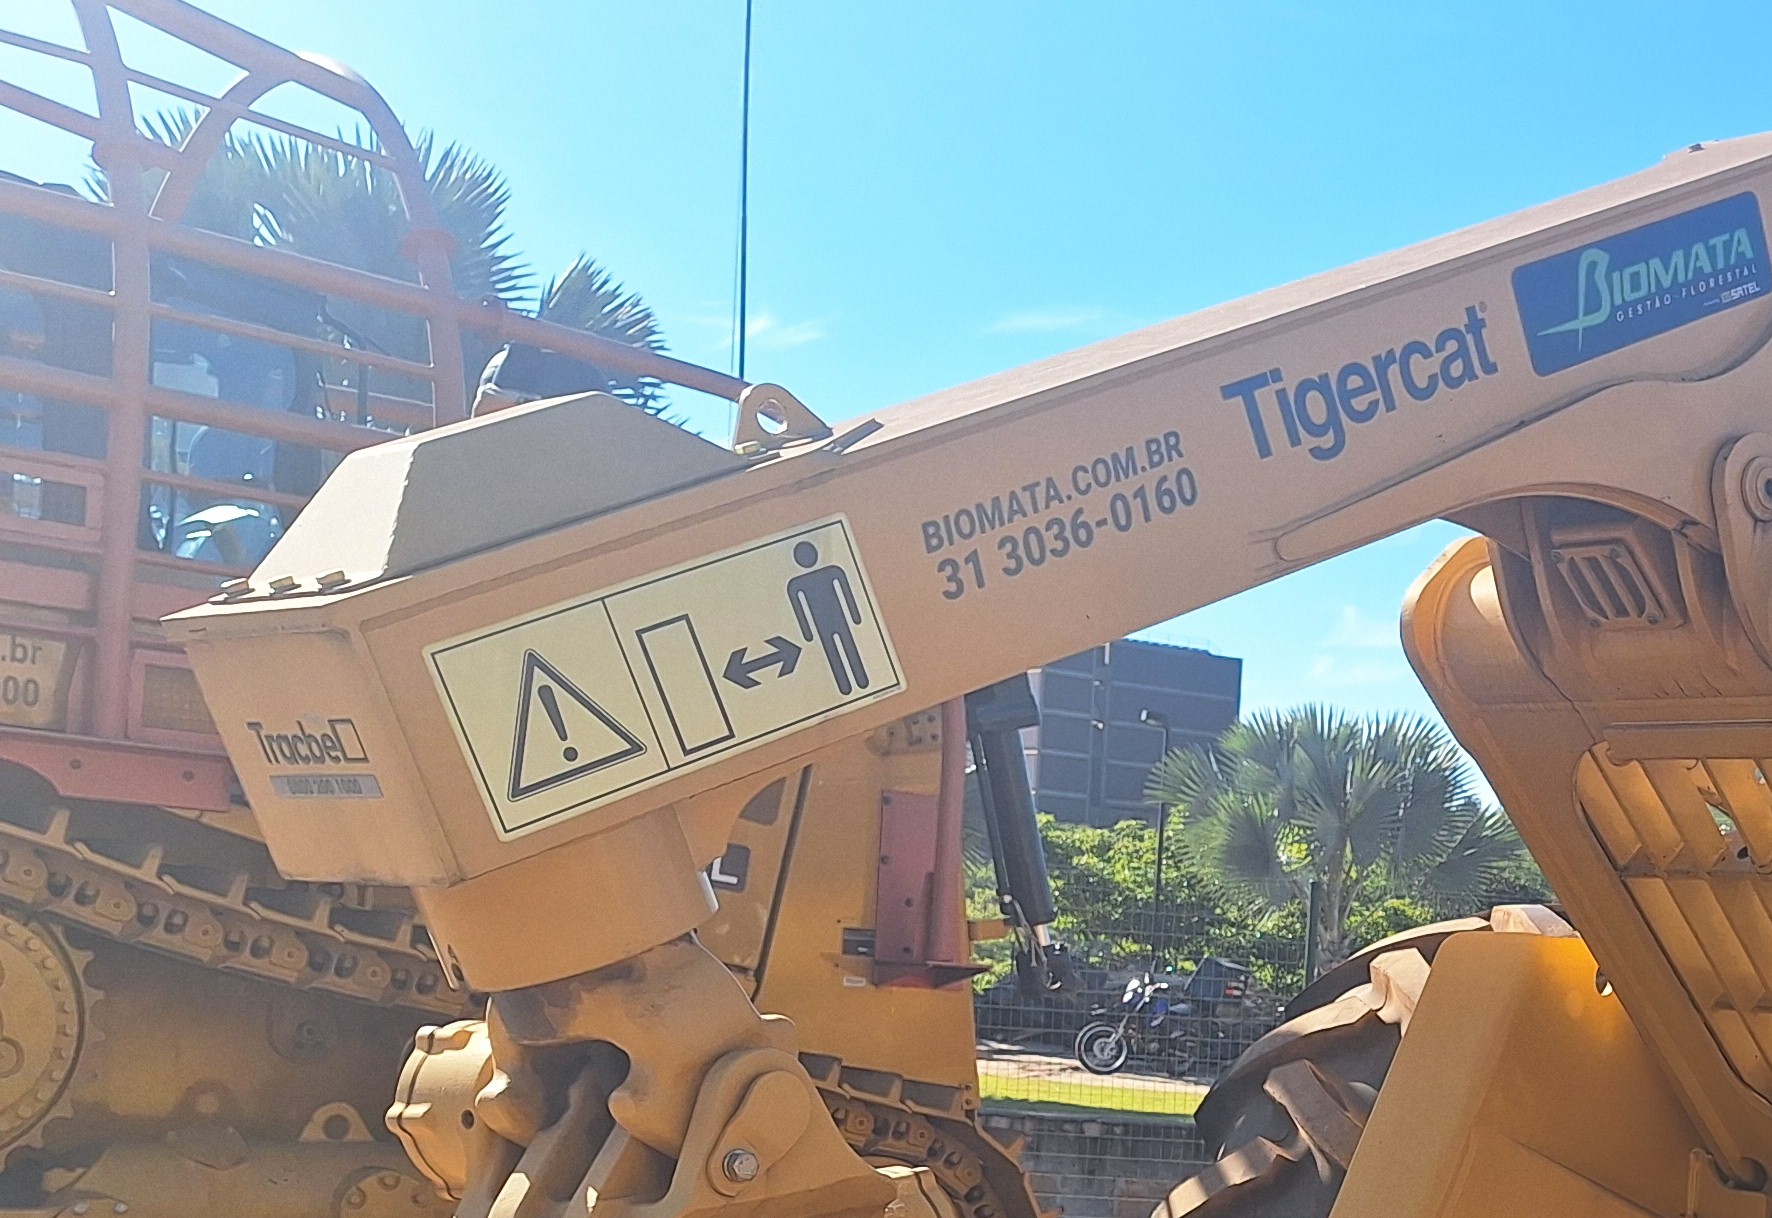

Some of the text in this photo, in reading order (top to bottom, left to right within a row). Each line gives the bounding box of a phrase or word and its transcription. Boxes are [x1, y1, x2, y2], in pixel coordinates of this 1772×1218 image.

[1537, 227, 1755, 352] BIOMATA
[1681, 263, 1759, 298] FLORESTAL
[1219, 303, 1499, 461] Tigercat
[921, 430, 1185, 554] BIOMATA.COM.BR
[936, 466, 1198, 600] 31 3036-0160
